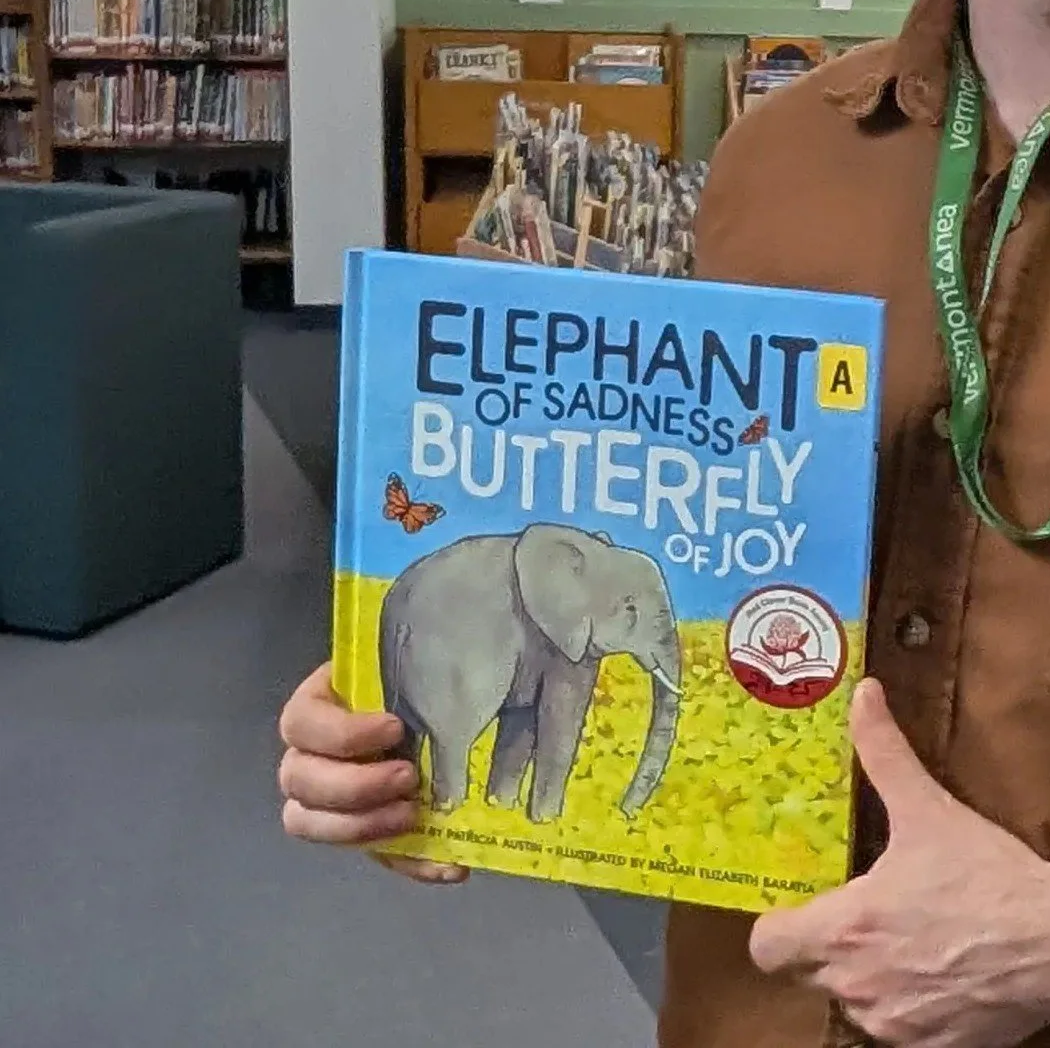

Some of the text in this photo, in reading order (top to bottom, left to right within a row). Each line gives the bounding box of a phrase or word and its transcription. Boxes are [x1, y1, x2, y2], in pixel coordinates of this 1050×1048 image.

[416, 300, 818, 432] ELEPHANT
[830, 361, 854, 395] A
[475, 382, 735, 456] OF SADNESS
[411, 401, 813, 536] BUTTERFLY
[665, 522, 807, 578] OF JOY
[630, 857, 646, 869] BY
